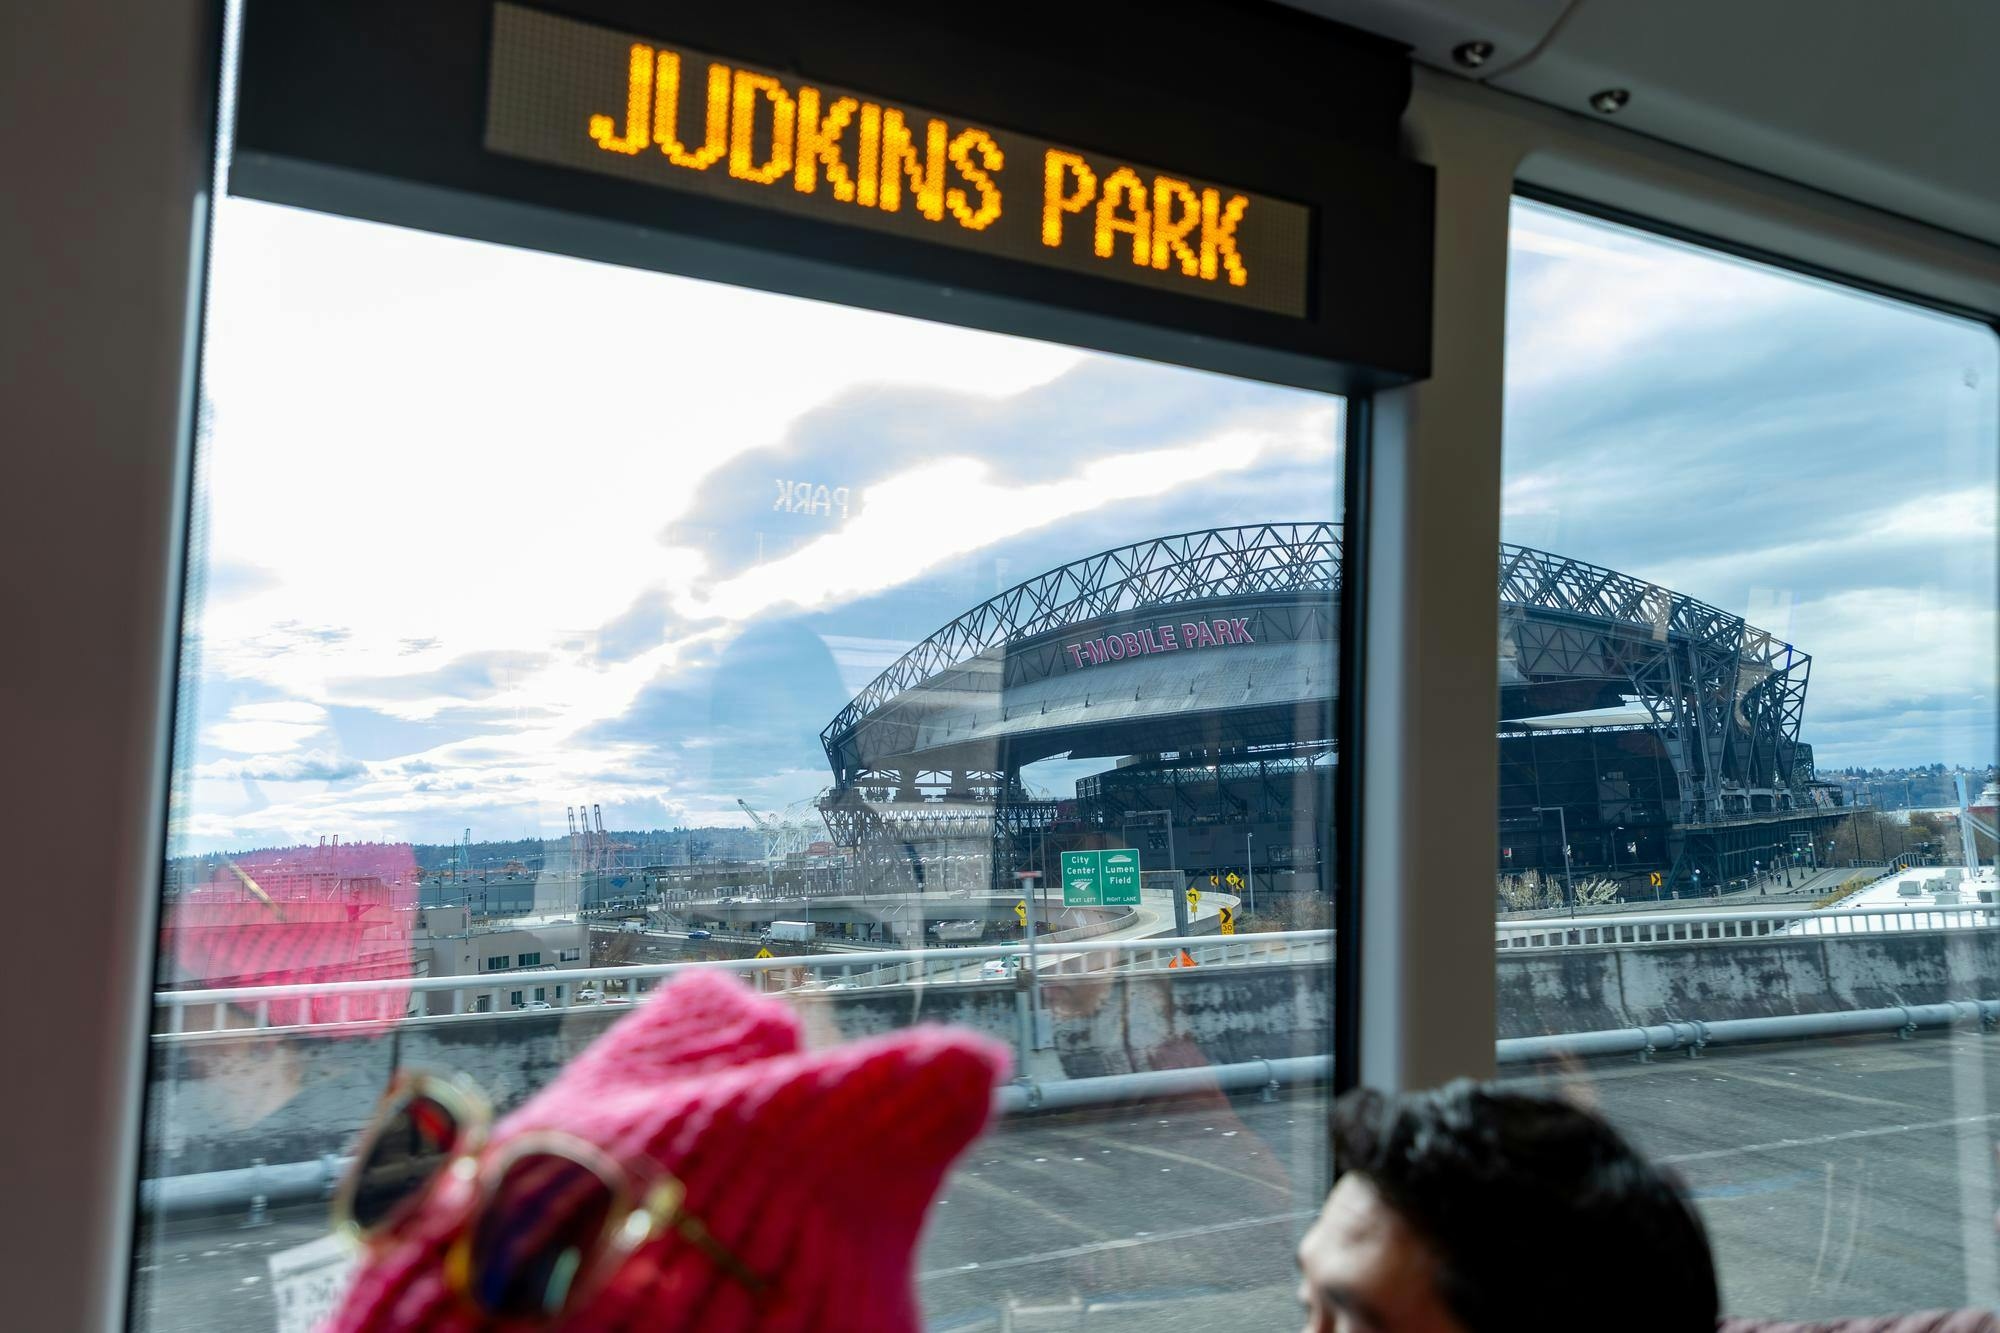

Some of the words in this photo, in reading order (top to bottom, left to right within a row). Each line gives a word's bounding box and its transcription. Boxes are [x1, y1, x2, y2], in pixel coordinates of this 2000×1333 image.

[590, 44, 1003, 230] JUDKINS
[1042, 149, 1249, 286] PARK
[1066, 625, 1179, 668] T-MOBILE
[1181, 617, 1255, 649] PARK
[1066, 867, 1096, 875] Center
[1071, 856, 1089, 864] City
